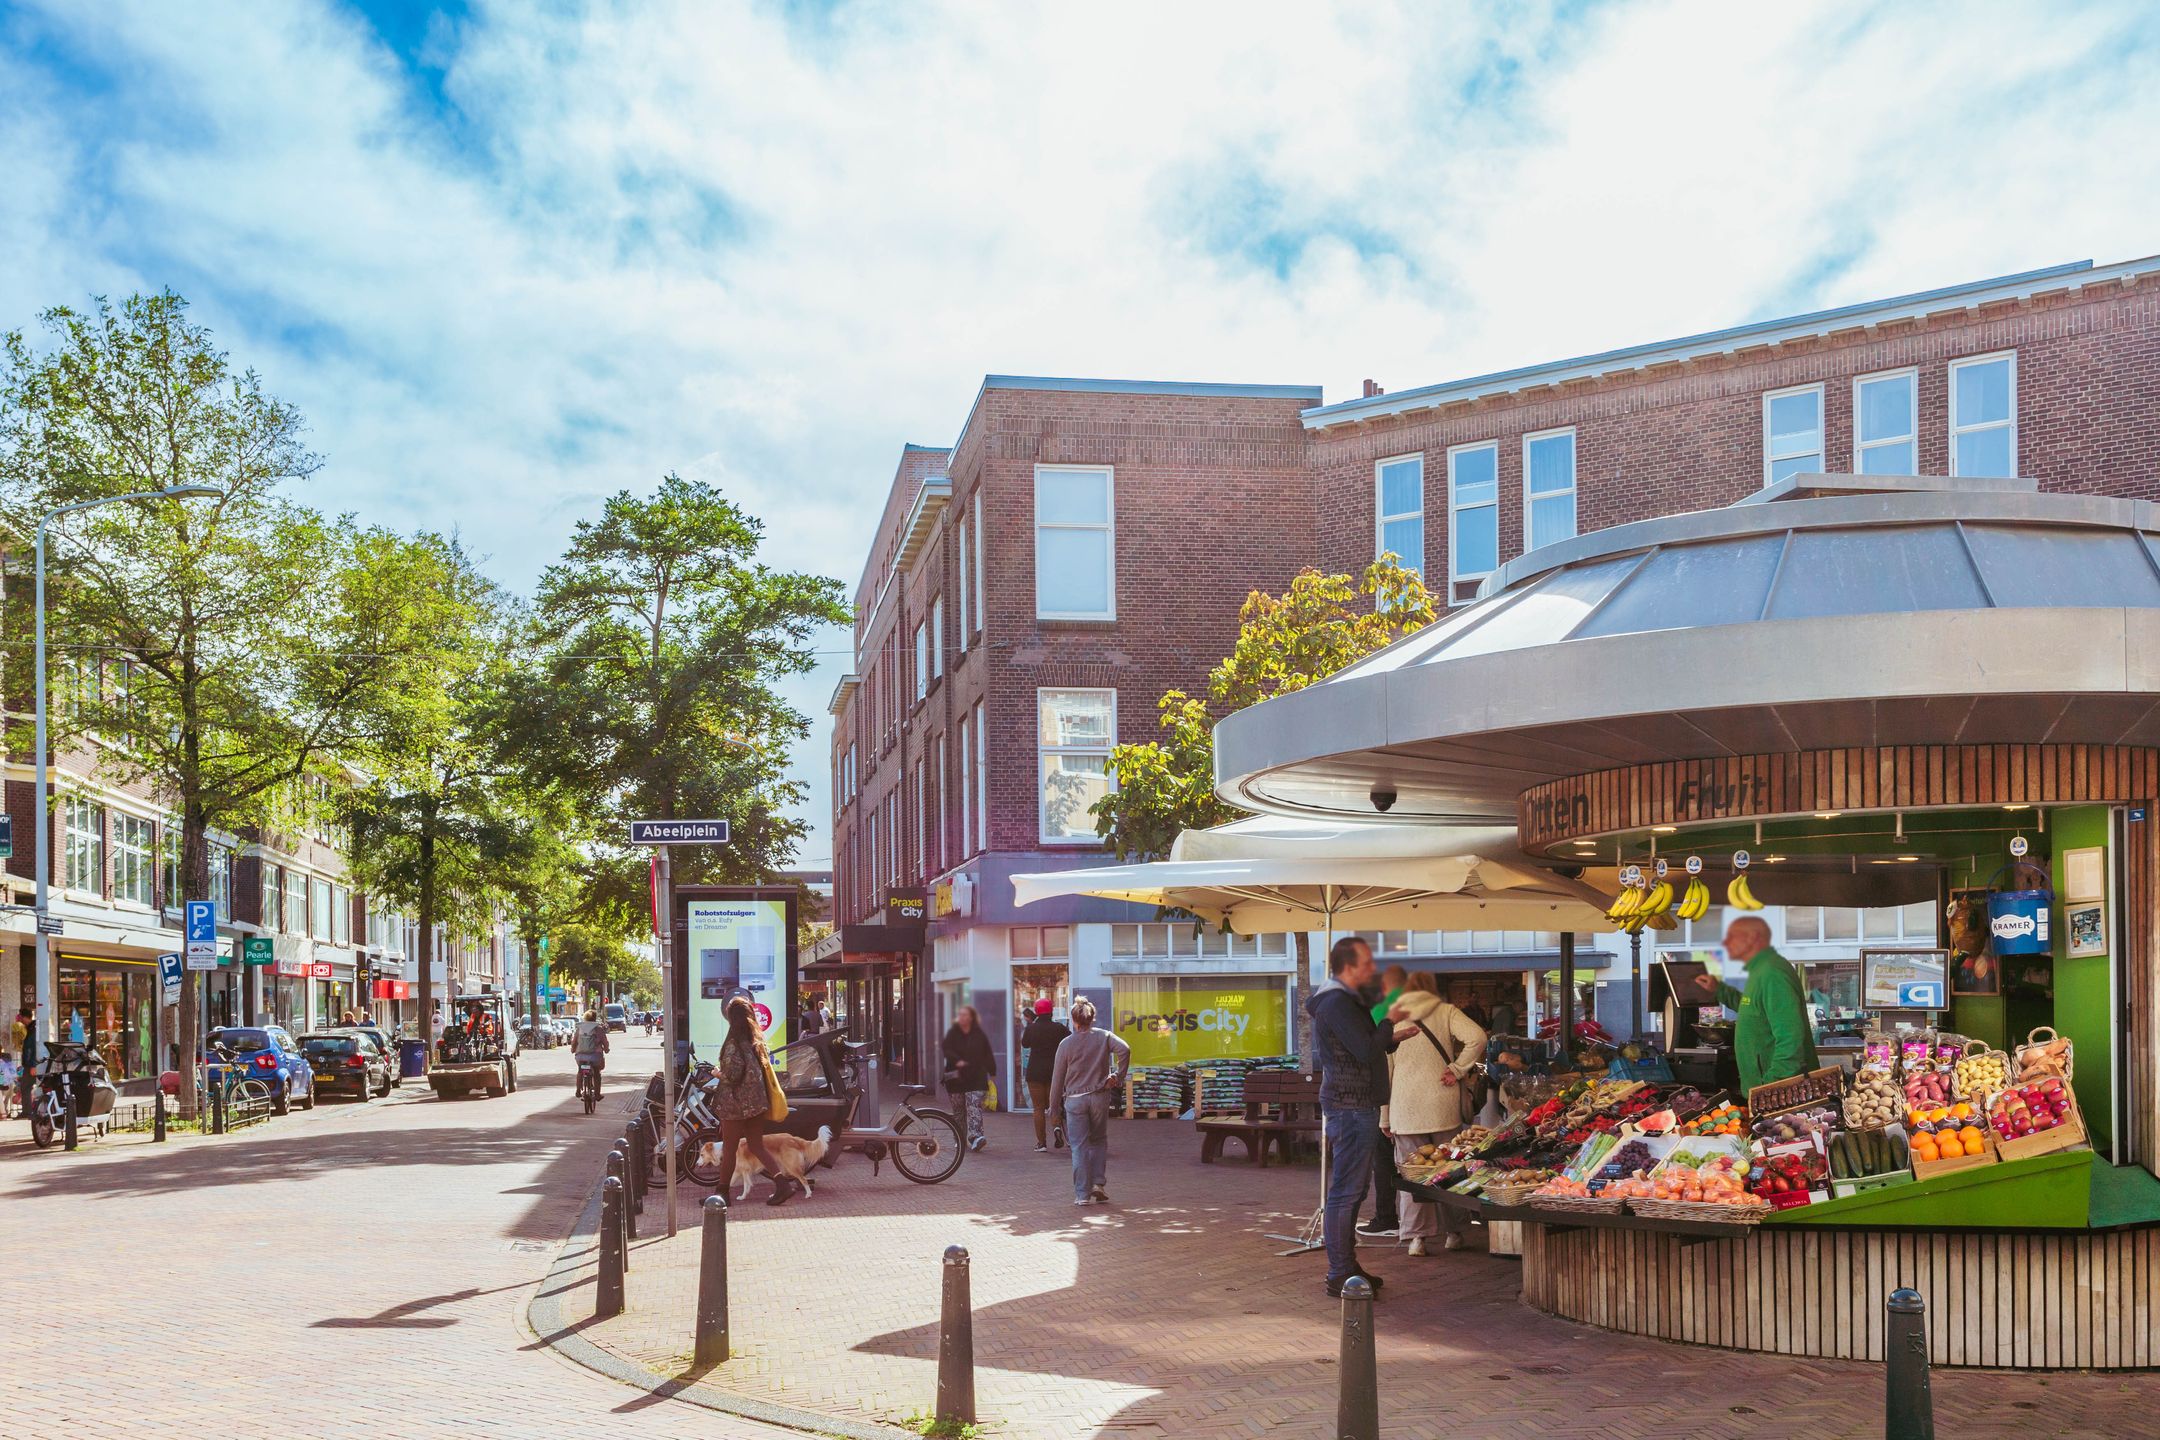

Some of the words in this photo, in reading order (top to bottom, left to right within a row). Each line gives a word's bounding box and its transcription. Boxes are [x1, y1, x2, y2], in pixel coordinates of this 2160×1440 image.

[1677, 773, 1768, 813] Fruit
[642, 824, 718, 839] Abeelplein
[890, 897, 923, 907] Praxis
[193, 905, 209, 925] P
[694, 910, 756, 918] Robotstofzuigers
[901, 907, 923, 919] City
[1993, 921, 2031, 931] KRAMER
[246, 951, 272, 959] Pearle
[161, 956, 177, 974] P
